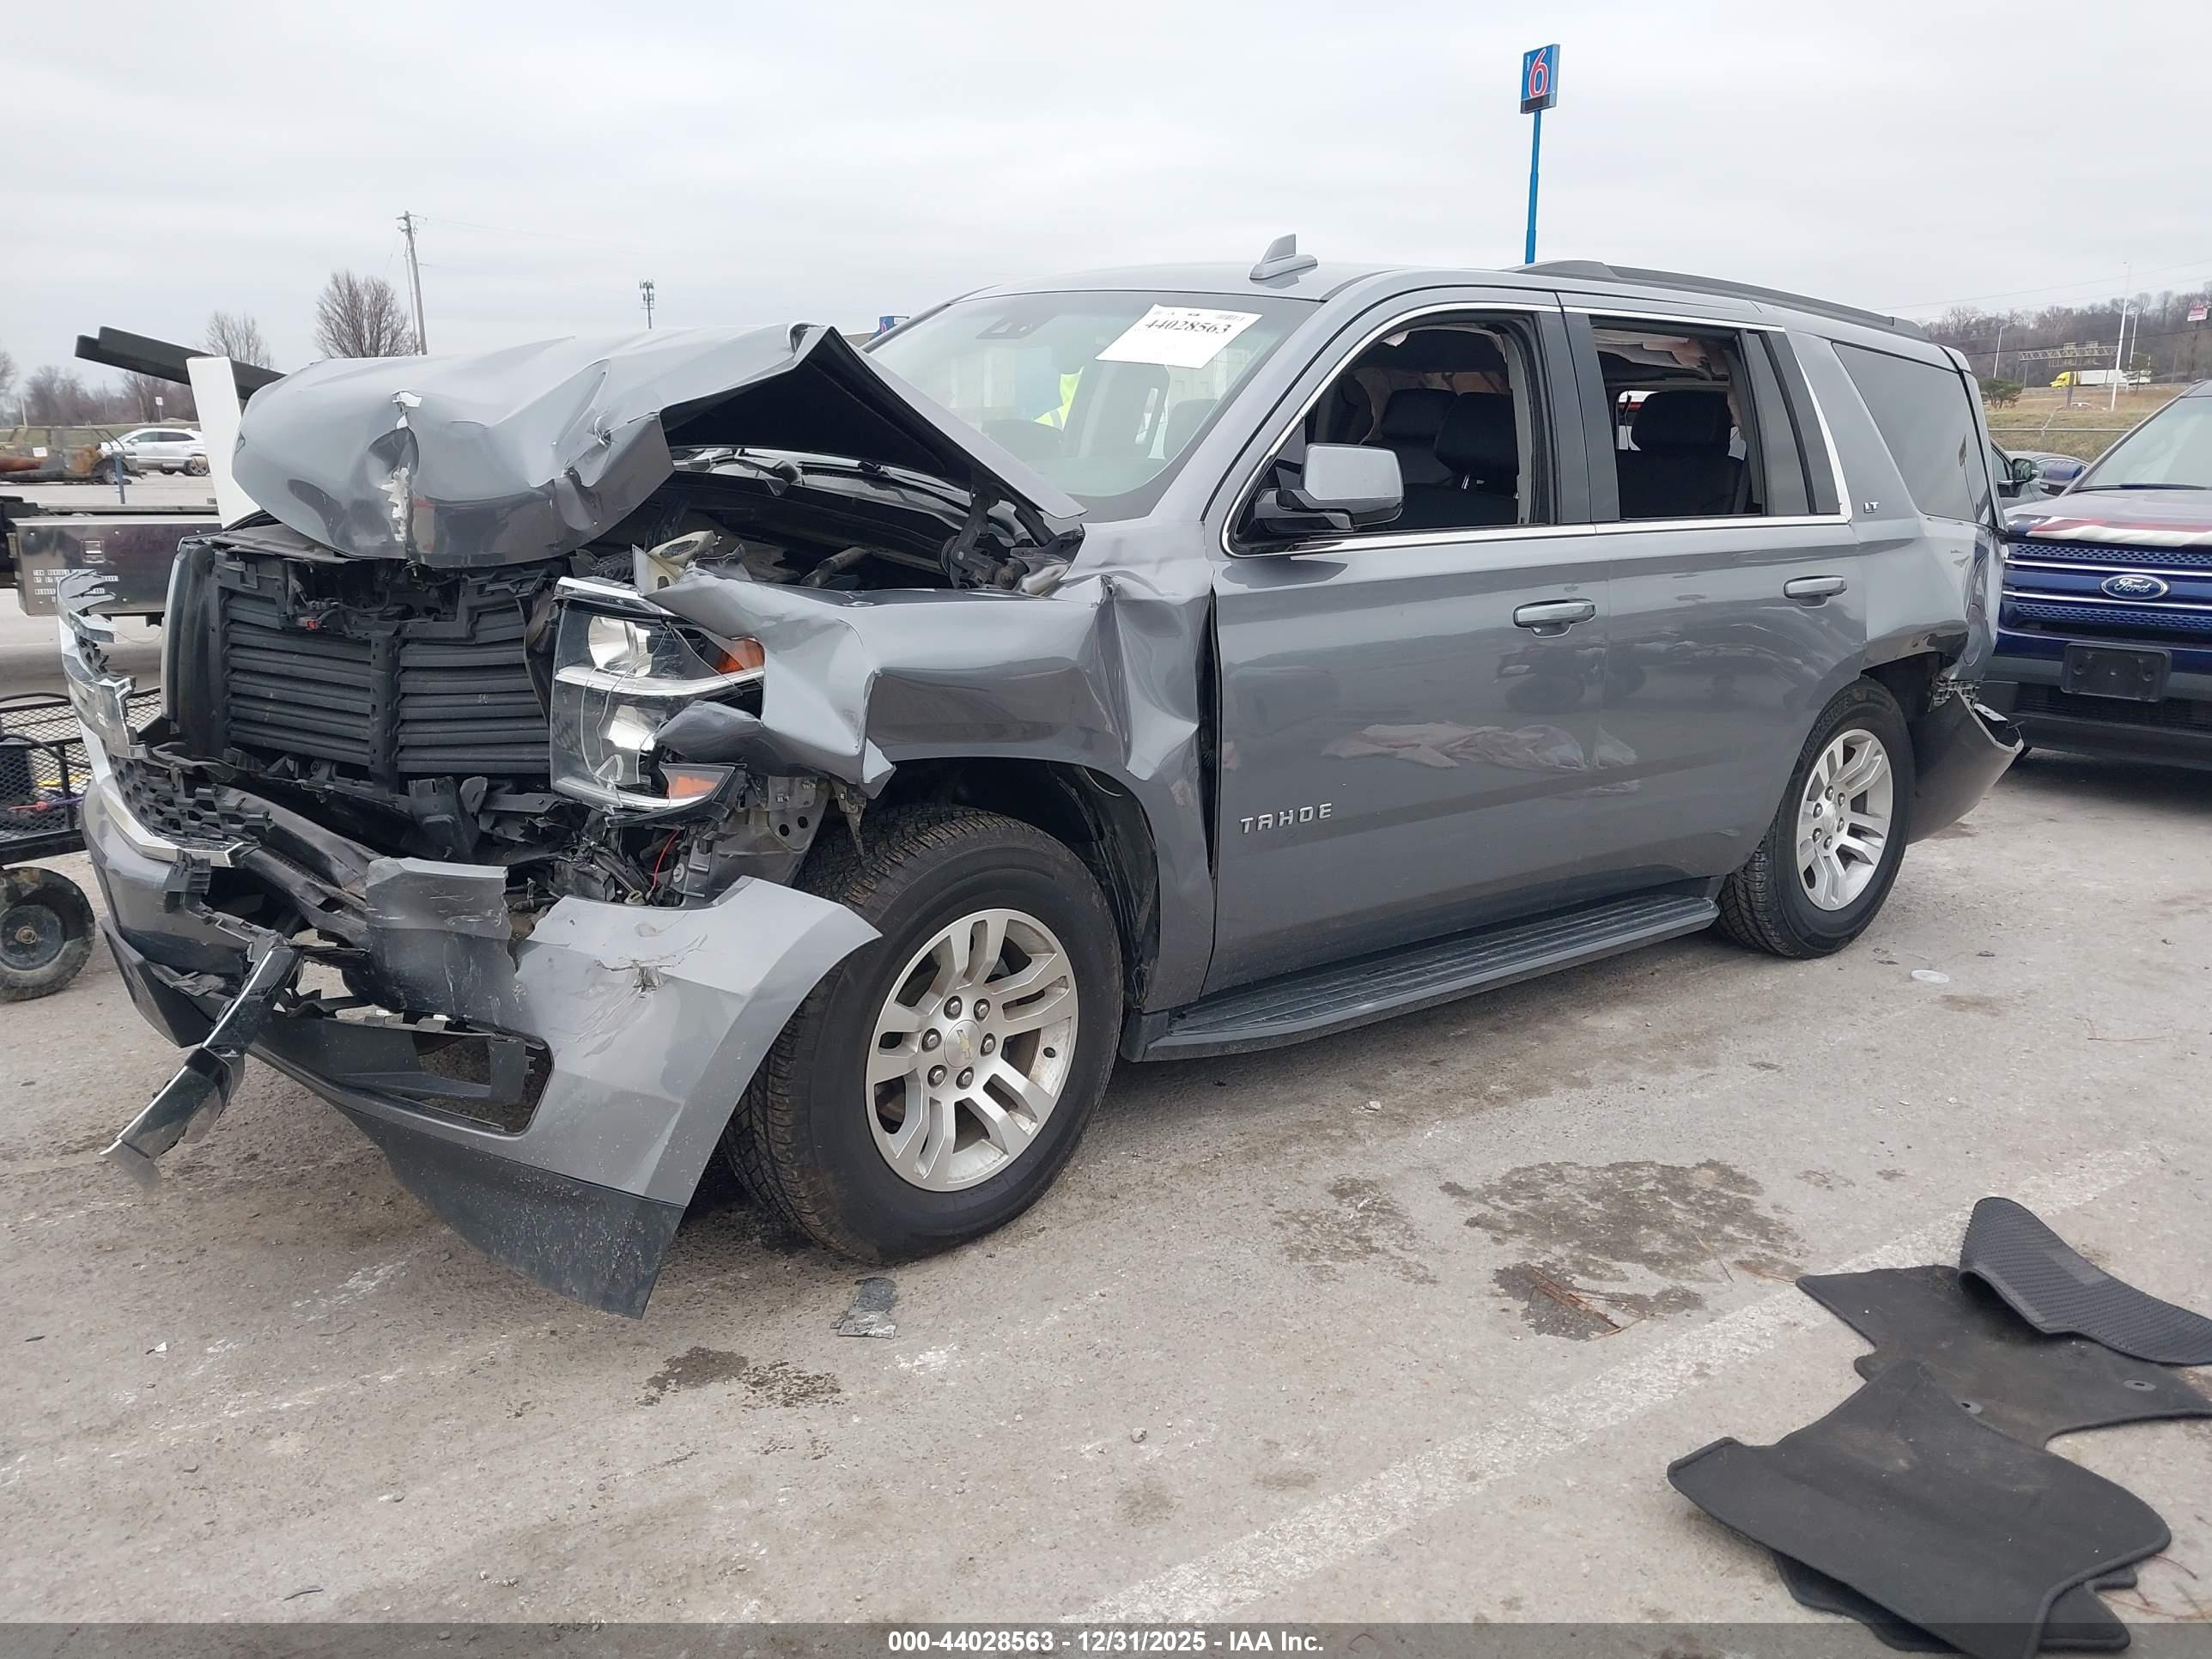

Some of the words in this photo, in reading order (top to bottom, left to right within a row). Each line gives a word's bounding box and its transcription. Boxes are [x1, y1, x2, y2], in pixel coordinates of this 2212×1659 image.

[1528, 48, 1549, 98] 6
[1145, 319, 1232, 334] 44028563
[1863, 501, 1880, 514] LT
[2114, 577, 2153, 592] Ford
[1240, 803, 1333, 834] TAHOE
